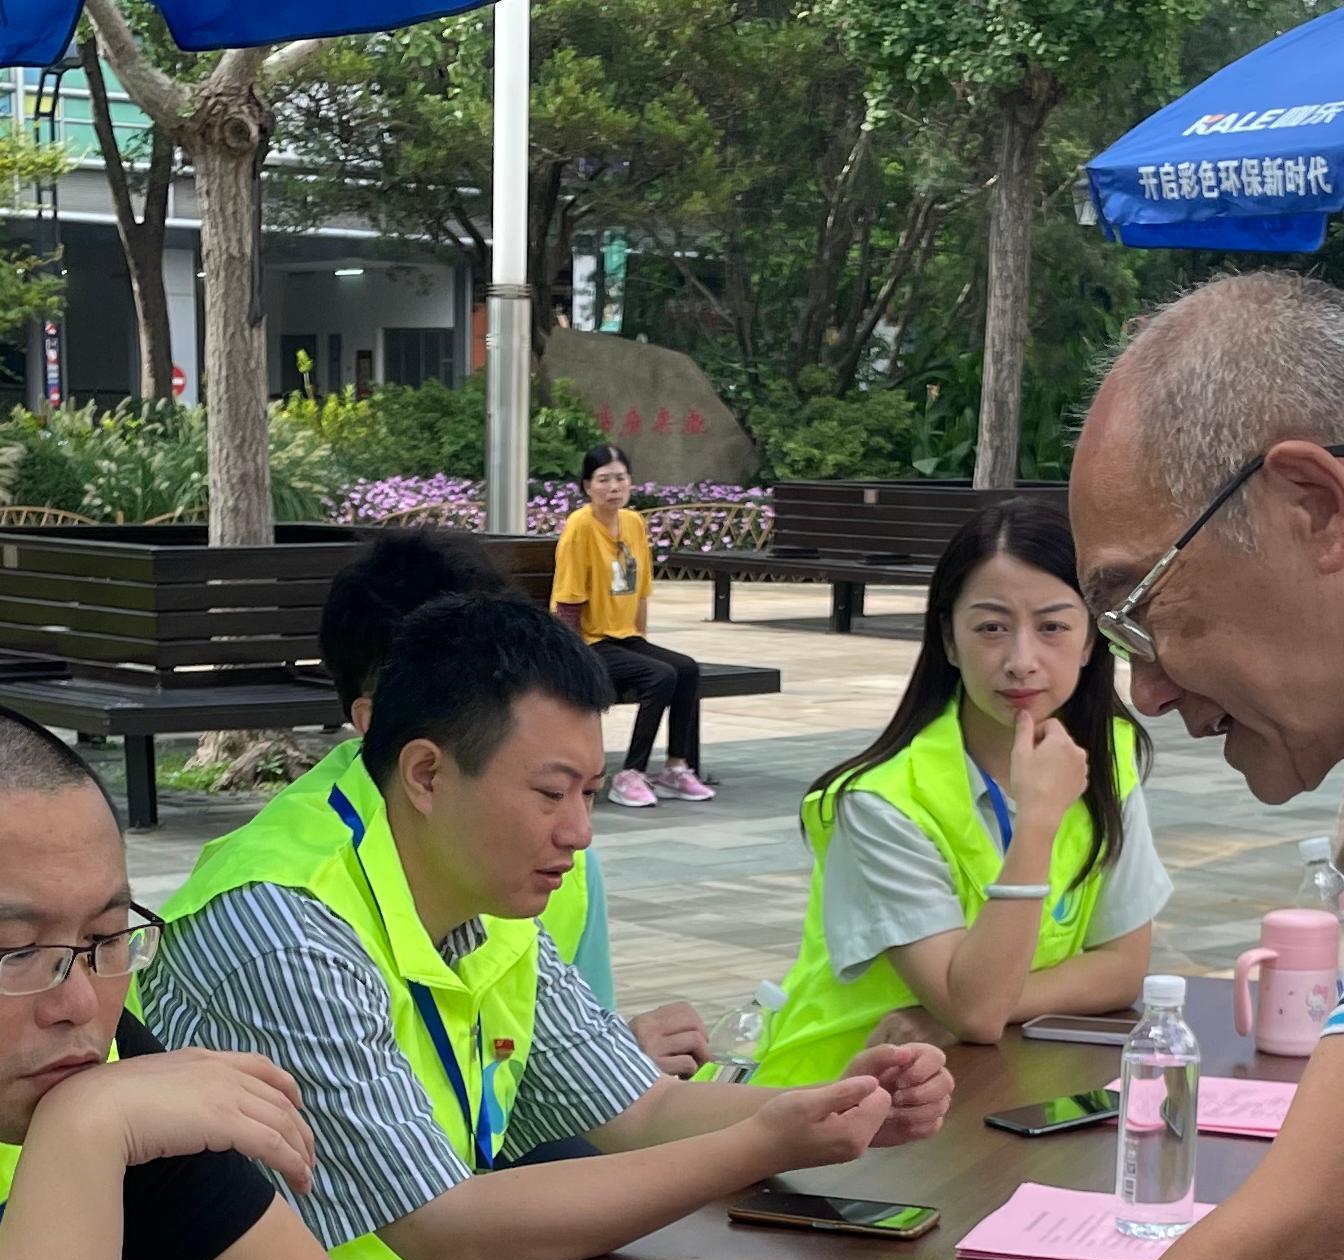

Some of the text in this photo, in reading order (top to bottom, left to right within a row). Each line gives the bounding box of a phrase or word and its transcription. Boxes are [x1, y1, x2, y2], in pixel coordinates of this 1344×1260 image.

[1137, 155, 1335, 201] 开启彩色环保新时代
